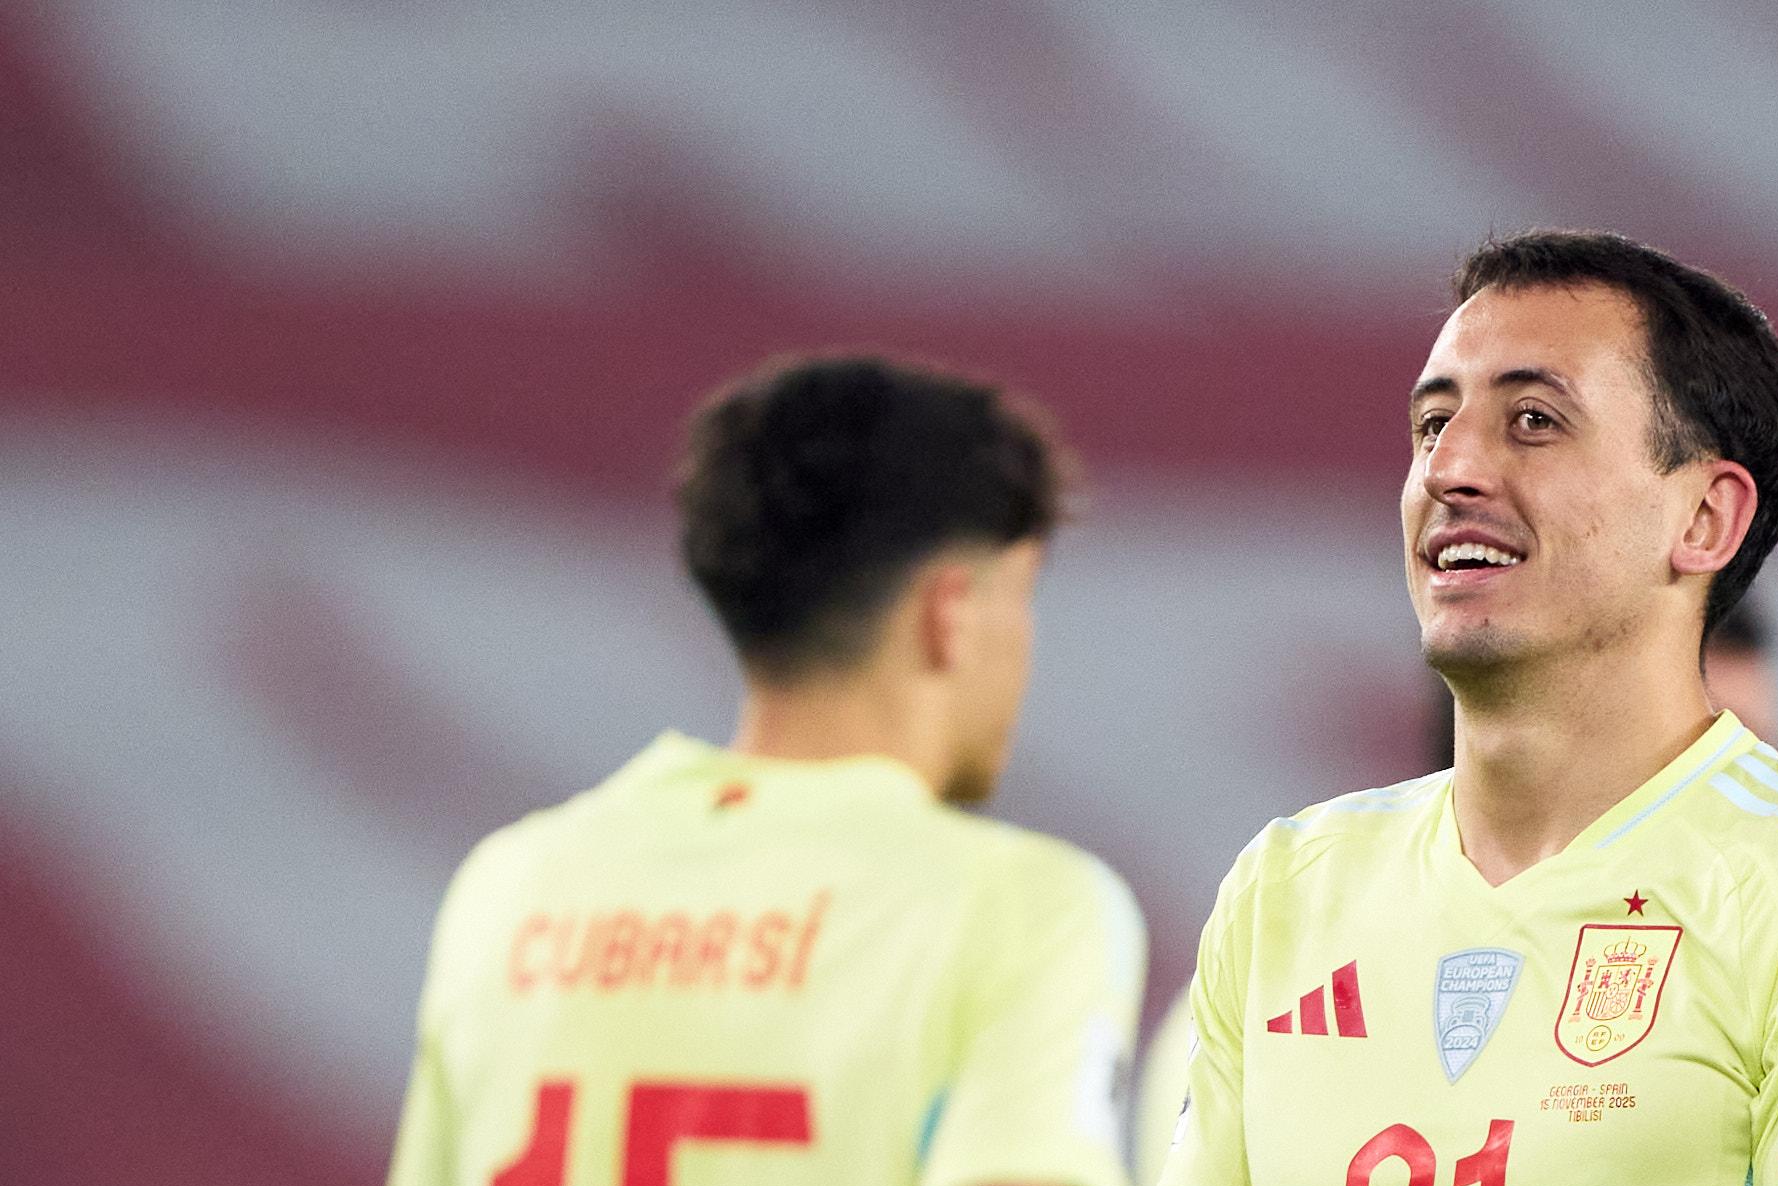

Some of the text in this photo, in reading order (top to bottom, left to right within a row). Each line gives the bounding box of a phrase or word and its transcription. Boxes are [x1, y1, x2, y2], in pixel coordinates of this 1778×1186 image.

[507, 888, 830, 993] CUBARSÍ
[1444, 966, 1513, 979] EUROPEAN
[1440, 979, 1511, 992] CHAMPIONS
[1443, 1037, 1478, 1050] 2024
[1550, 1085, 1588, 1097] GEORGIA
[1599, 1083, 1628, 1095] SPAIN
[1552, 1097, 1605, 1110] NOVEMBER
[1608, 1096, 1636, 1108] 2025
